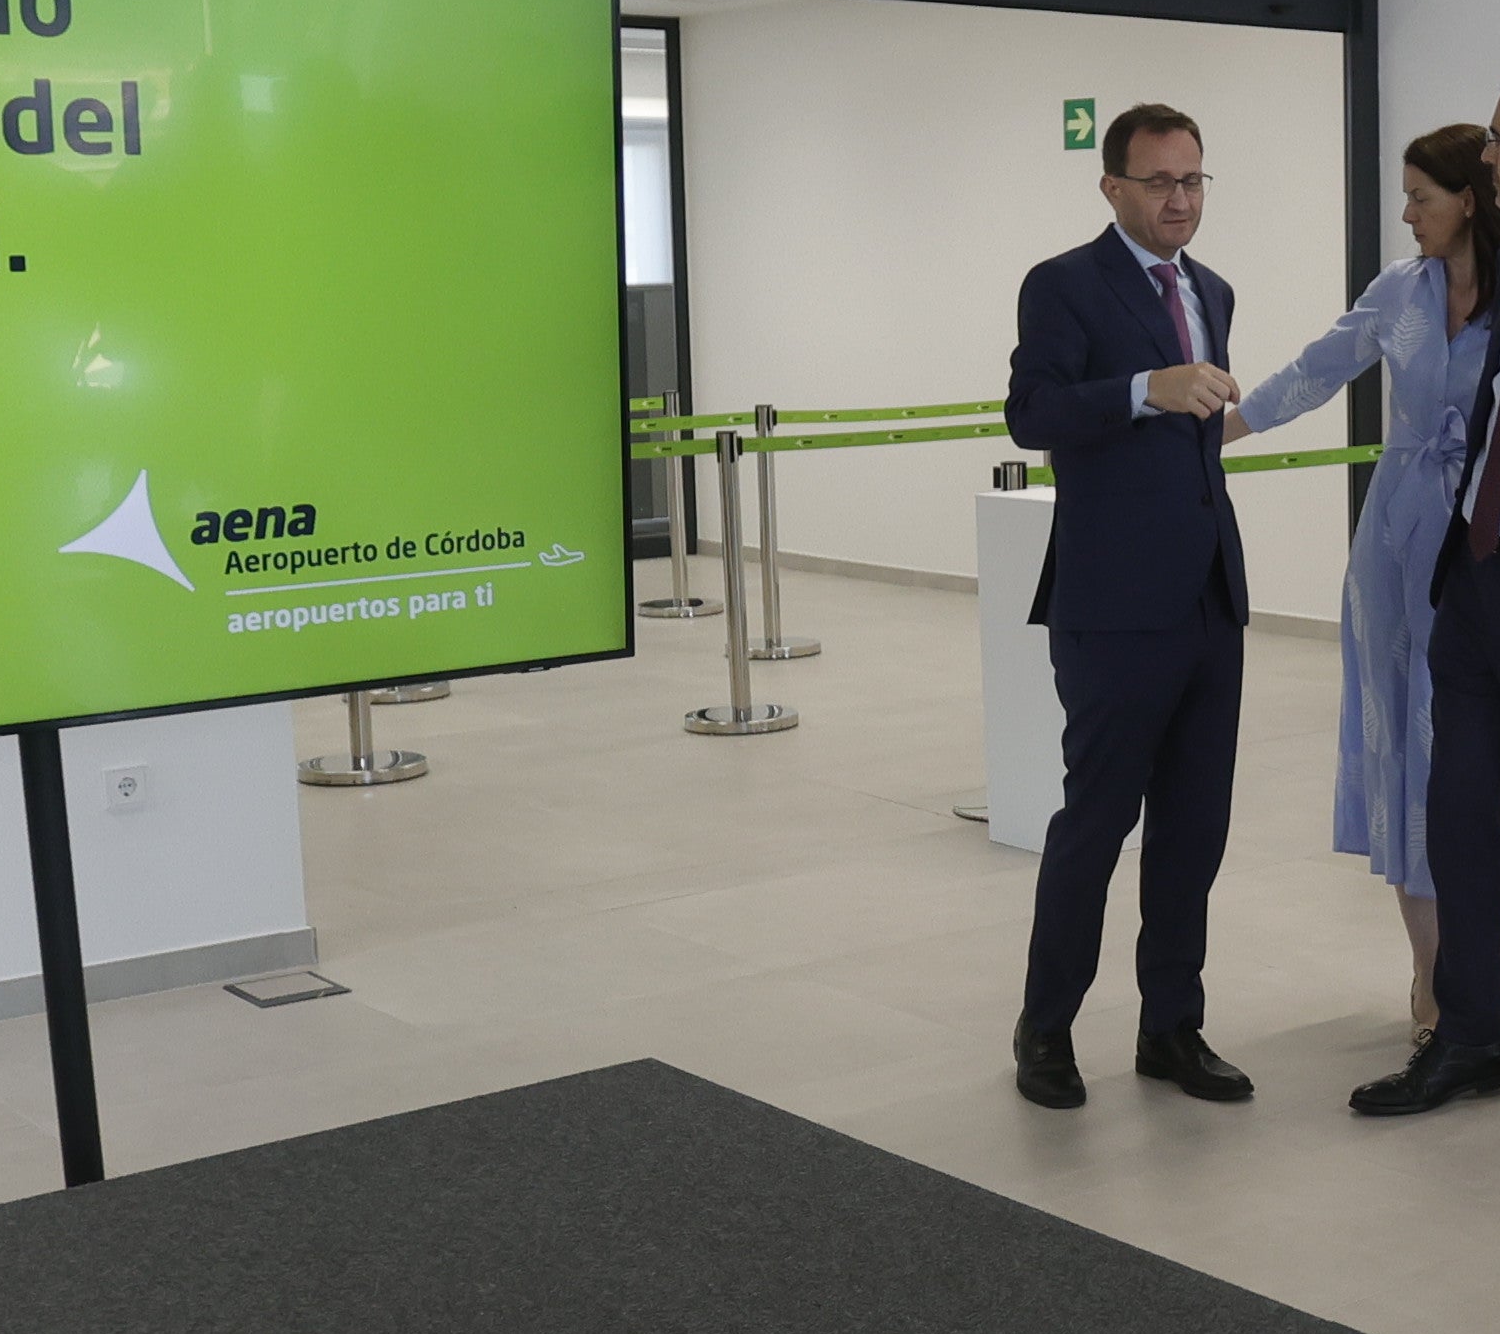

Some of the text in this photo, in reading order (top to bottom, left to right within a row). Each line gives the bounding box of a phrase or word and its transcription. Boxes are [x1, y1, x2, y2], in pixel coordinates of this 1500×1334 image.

[2, 80, 141, 155] del
[191, 504, 316, 545] aena
[225, 527, 524, 574] Aeropuerto de Córdoba
[228, 582, 493, 633] aeropuertos para ti
